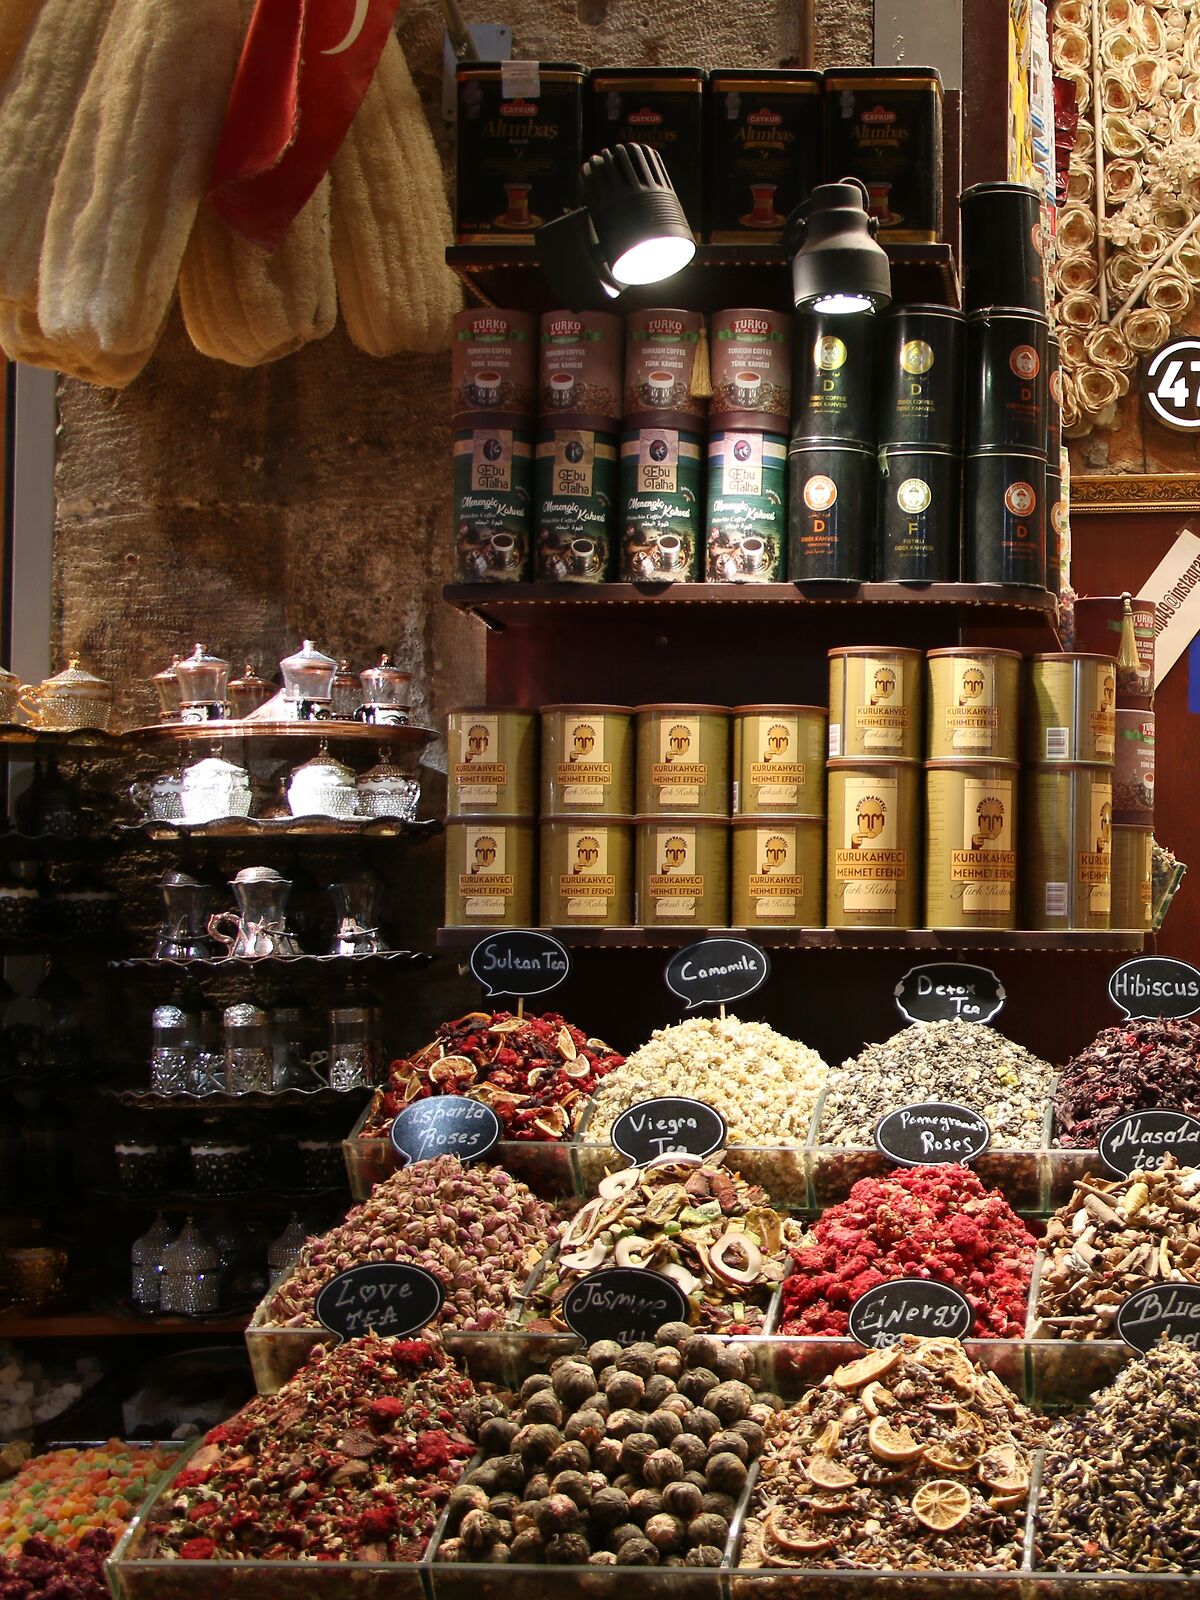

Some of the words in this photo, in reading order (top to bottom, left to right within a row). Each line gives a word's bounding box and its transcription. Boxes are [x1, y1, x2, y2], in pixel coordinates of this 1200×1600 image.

[473, 319, 507, 330] TURKO
[551, 320, 581, 331] TURKO
[649, 319, 682, 330] TURKO
[734, 319, 768, 330] TURKO
[823, 380, 835, 391] D
[910, 384, 922, 395] D
[477, 464, 505, 477] Ebu
[559, 469, 586, 482] Ebu
[643, 465, 670, 479] Ebu
[728, 468, 755, 482] Ebu
[478, 476, 509, 489] Talha
[560, 480, 589, 494] Talha
[644, 477, 674, 491] Talha
[729, 480, 759, 493] Talha
[814, 520, 825, 532] D
[908, 522, 918, 535] F
[1017, 526, 1027, 538] D
[558, 775, 585, 783] MEHMET
[752, 775, 780, 783] MEHMET
[837, 868, 873, 877] MEHMET
[954, 869, 992, 877] MEHMET
[460, 887, 487, 895] MEHMET
[561, 887, 589, 895] MEHMET
[483, 944, 541, 970] Sultan
[542, 951, 565, 970] Tea
[681, 955, 757, 981] Camomile
[917, 975, 975, 995] Detox
[1115, 973, 1200, 997] Hibiscus
[950, 997, 981, 1015] Tea
[630, 1115, 697, 1135] Viegra
[418, 1128, 480, 1154] Roses
[920, 1131, 974, 1154] Roses
[1110, 1119, 1200, 1153] Masala
[649, 1137, 688, 1154] Tea
[346, 1305, 398, 1330] TEA
